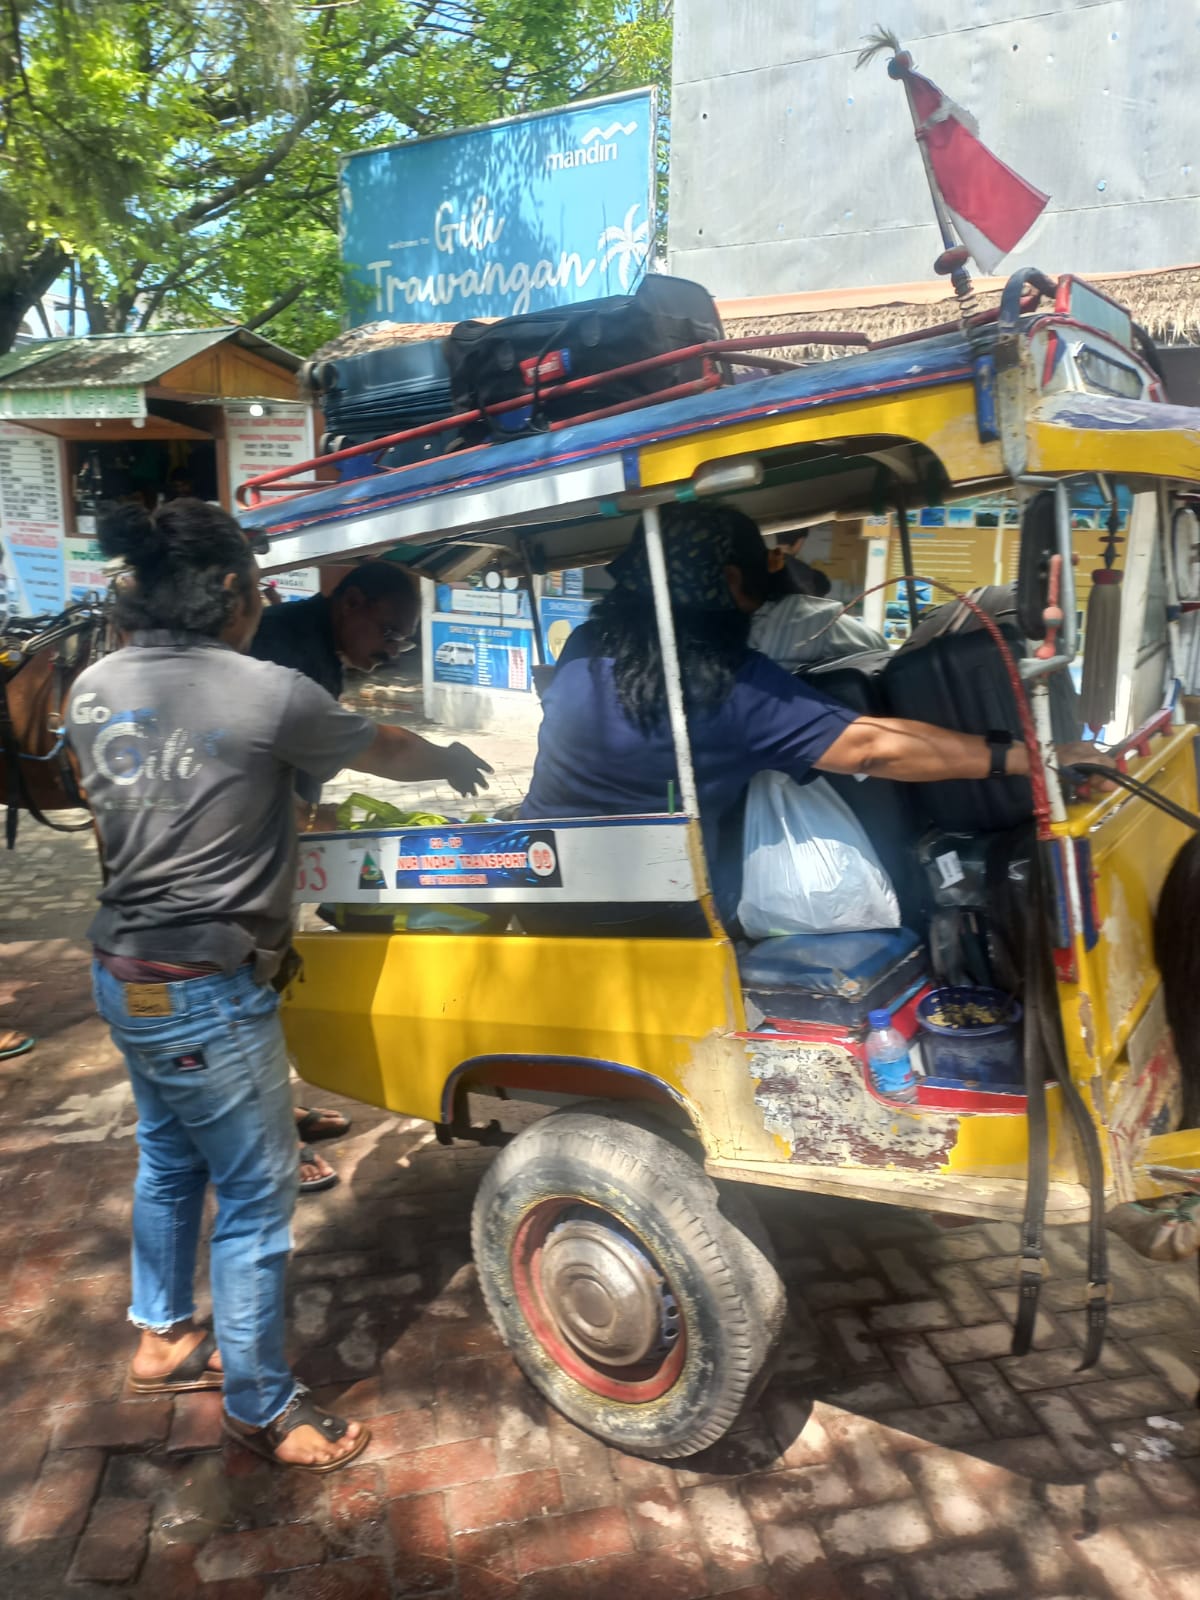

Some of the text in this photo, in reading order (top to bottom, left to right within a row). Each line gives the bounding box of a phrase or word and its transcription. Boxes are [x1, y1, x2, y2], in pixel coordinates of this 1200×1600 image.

[434, 195, 505, 254] Gili
[367, 251, 597, 315] Trawangan
[71, 692, 112, 724] Go
[458, 852, 528, 869] TRANSPORT
